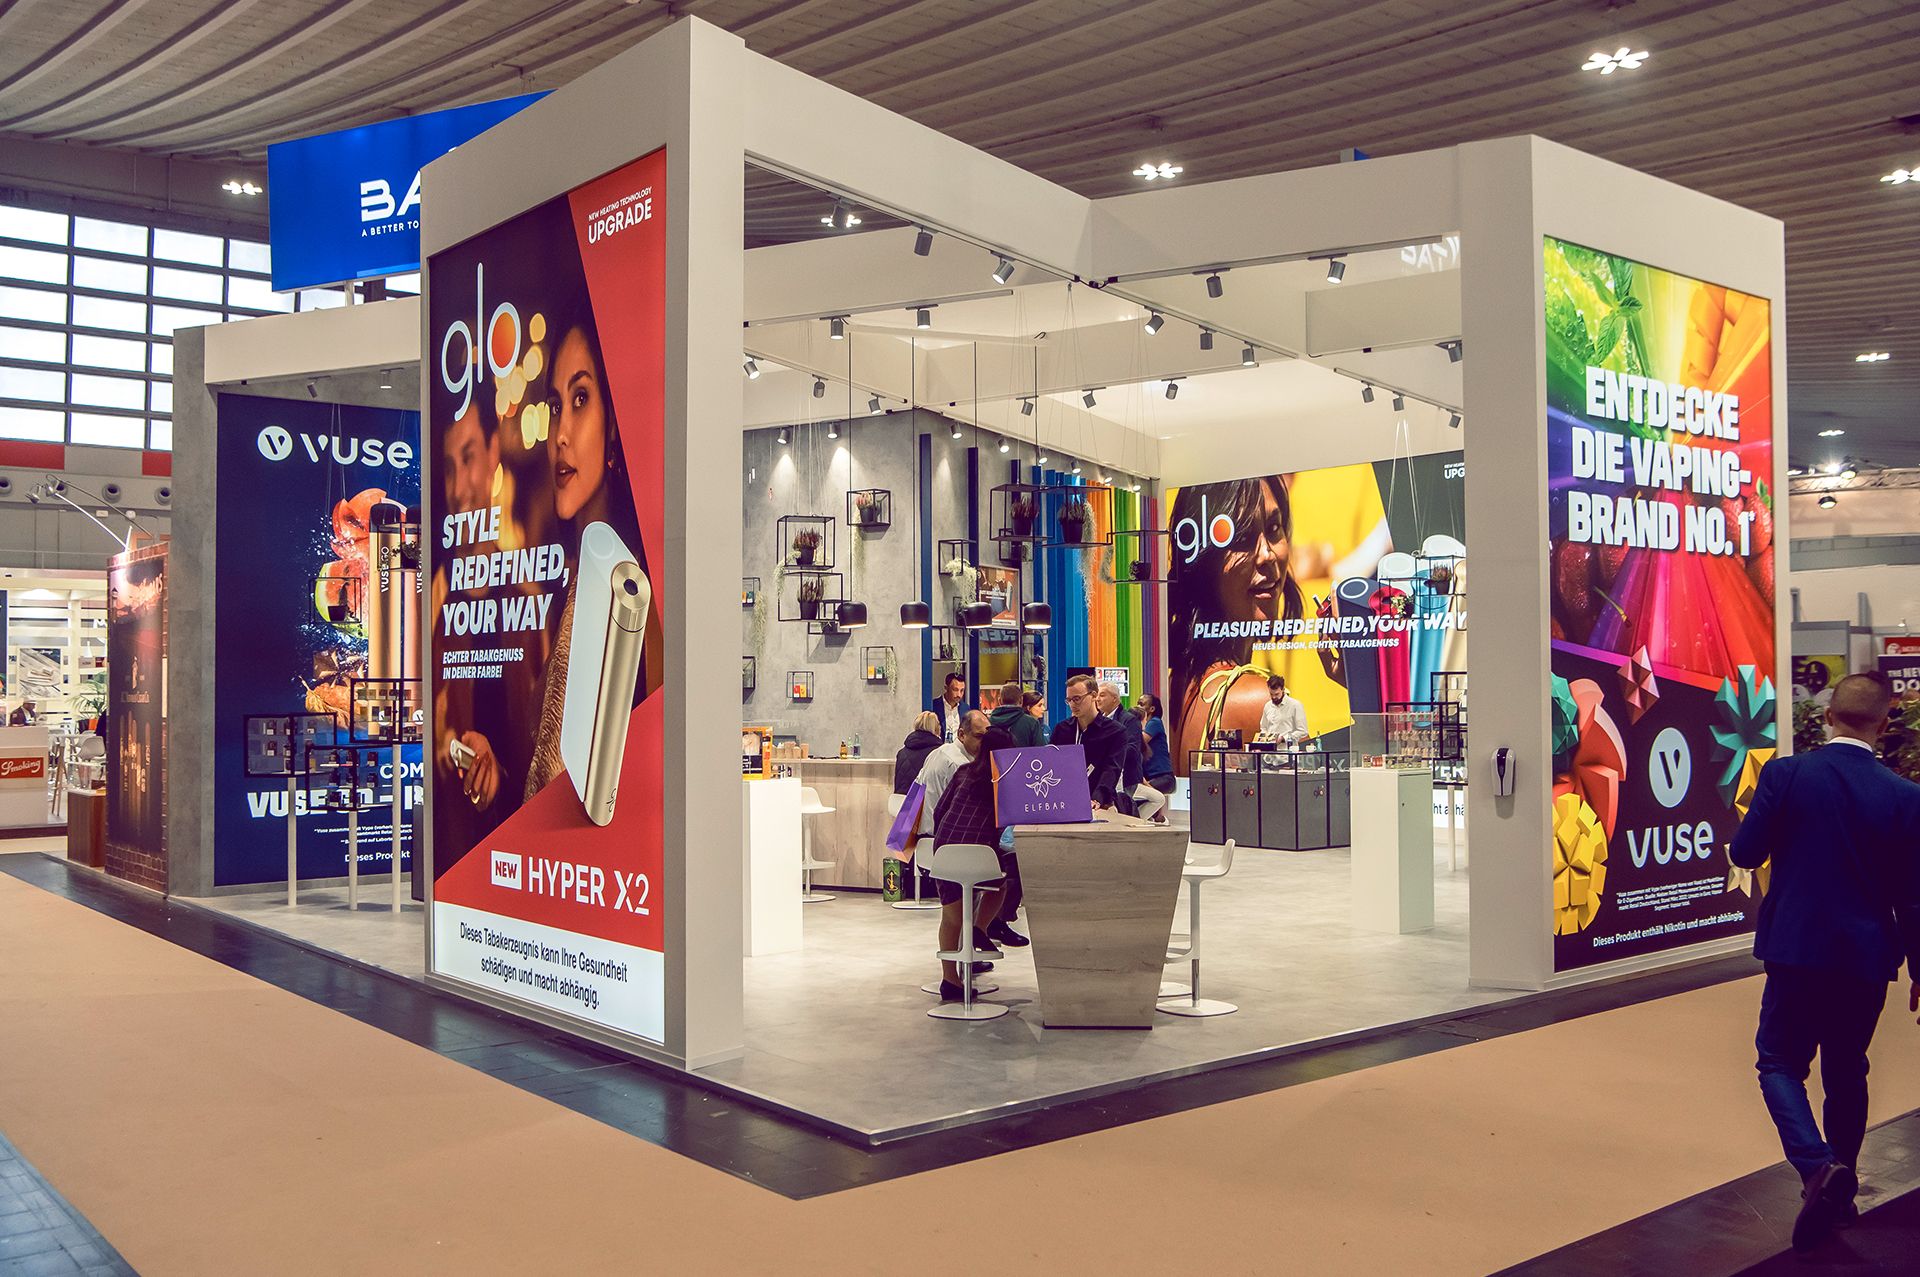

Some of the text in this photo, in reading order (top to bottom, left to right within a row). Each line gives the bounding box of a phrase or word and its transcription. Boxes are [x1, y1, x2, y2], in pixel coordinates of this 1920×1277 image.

[588, 186, 652, 221] NEW HEATING TECHNOLOGY
[588, 198, 652, 244] UPGRADE
[362, 229, 367, 237] A
[371, 223, 404, 236] BETTER
[442, 262, 522, 421] glo
[1586, 365, 1739, 441] ENTDECKE
[1572, 426, 1751, 499] DIE VAPING-
[442, 506, 501, 549] STYLE
[1176, 494, 1235, 564] glo
[1568, 490, 1680, 551] BRAND
[1684, 505, 1733, 556] NO.
[450, 543, 569, 591] REDEFINED,
[443, 593, 553, 636] YOUR WAY
[1193, 619, 1270, 639] PLEASURE
[1421, 611, 1468, 631] WAY
[443, 648, 524, 664] ECHTER TABAKGENUSS
[1252, 641, 1276, 650] NEUES
[1308, 639, 1339, 649] ECHTER
[1340, 638, 1399, 648] TABAKGENUSS
[443, 665, 502, 680] IN DEINER FARBE!
[1, 761, 41, 776] Smoking
[247, 788, 328, 818] VUSE
[1025, 802, 1065, 812] ELFBAR
[495, 856, 650, 915] NEW HYPER X2
[1593, 910, 1745, 947] Dieses Produkt enthält Nikotin und macht abhängig.
[460, 922, 628, 983] Dieses Tabakerzeugnis kann Ihre Gesundheit
[481, 956, 600, 1010] schädigen und macht abhängig.
